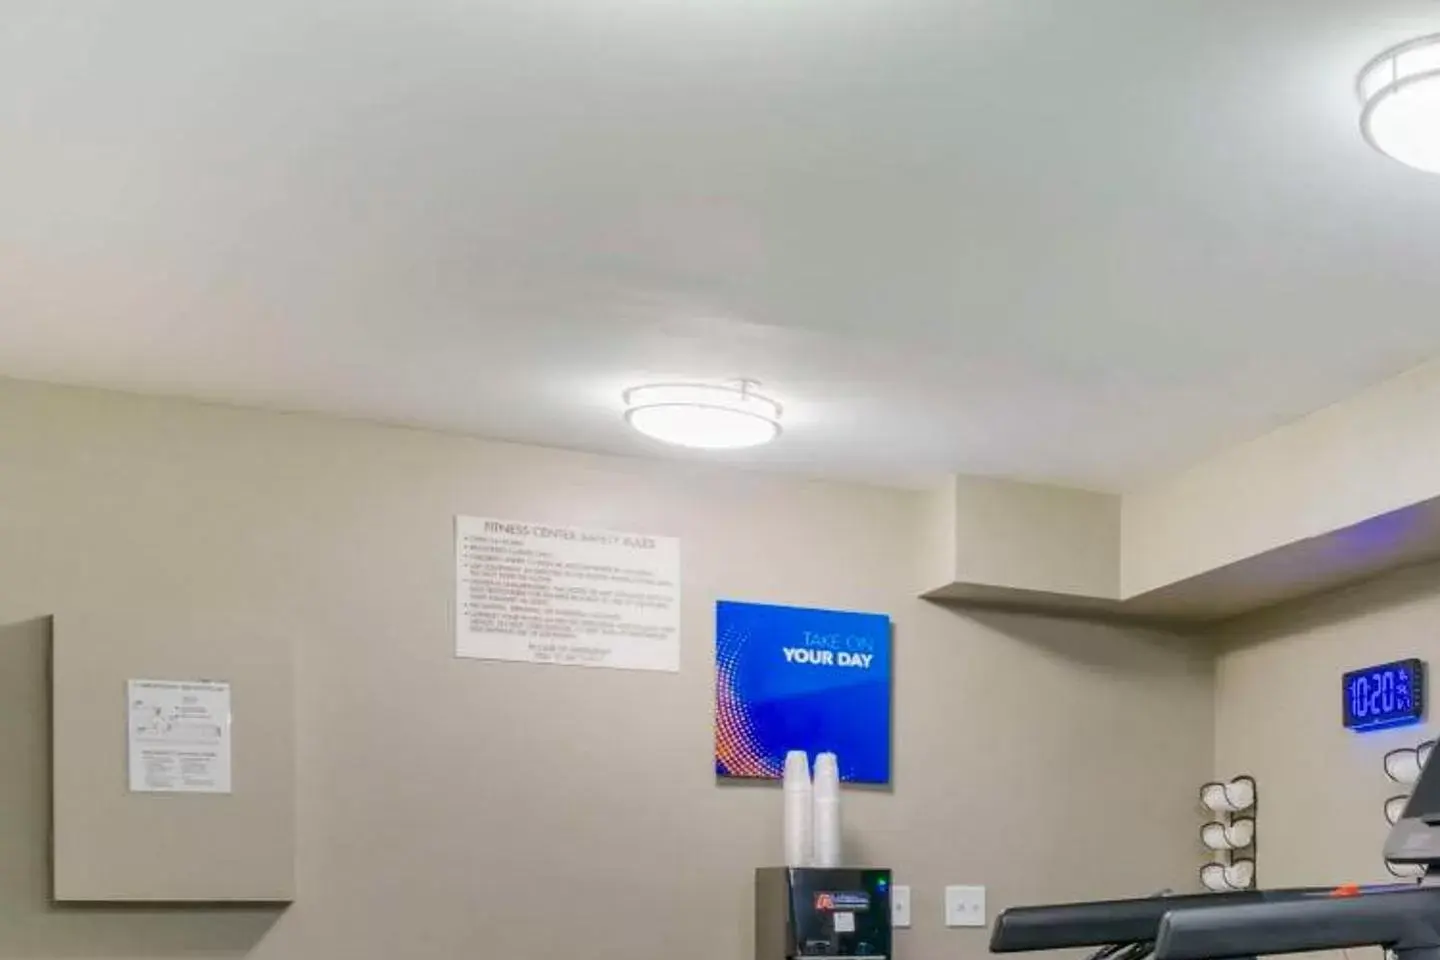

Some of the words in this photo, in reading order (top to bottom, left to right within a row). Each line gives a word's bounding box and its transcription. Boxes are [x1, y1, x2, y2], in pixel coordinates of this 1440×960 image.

[484, 520, 531, 537] FITNESS
[532, 525, 576, 541] CENTER
[803, 630, 841, 650] TAKE
[845, 634, 875, 652] ON
[782, 646, 834, 666] YOUR
[837, 651, 875, 669] DAY
[1348, 671, 1395, 717] 10:20
